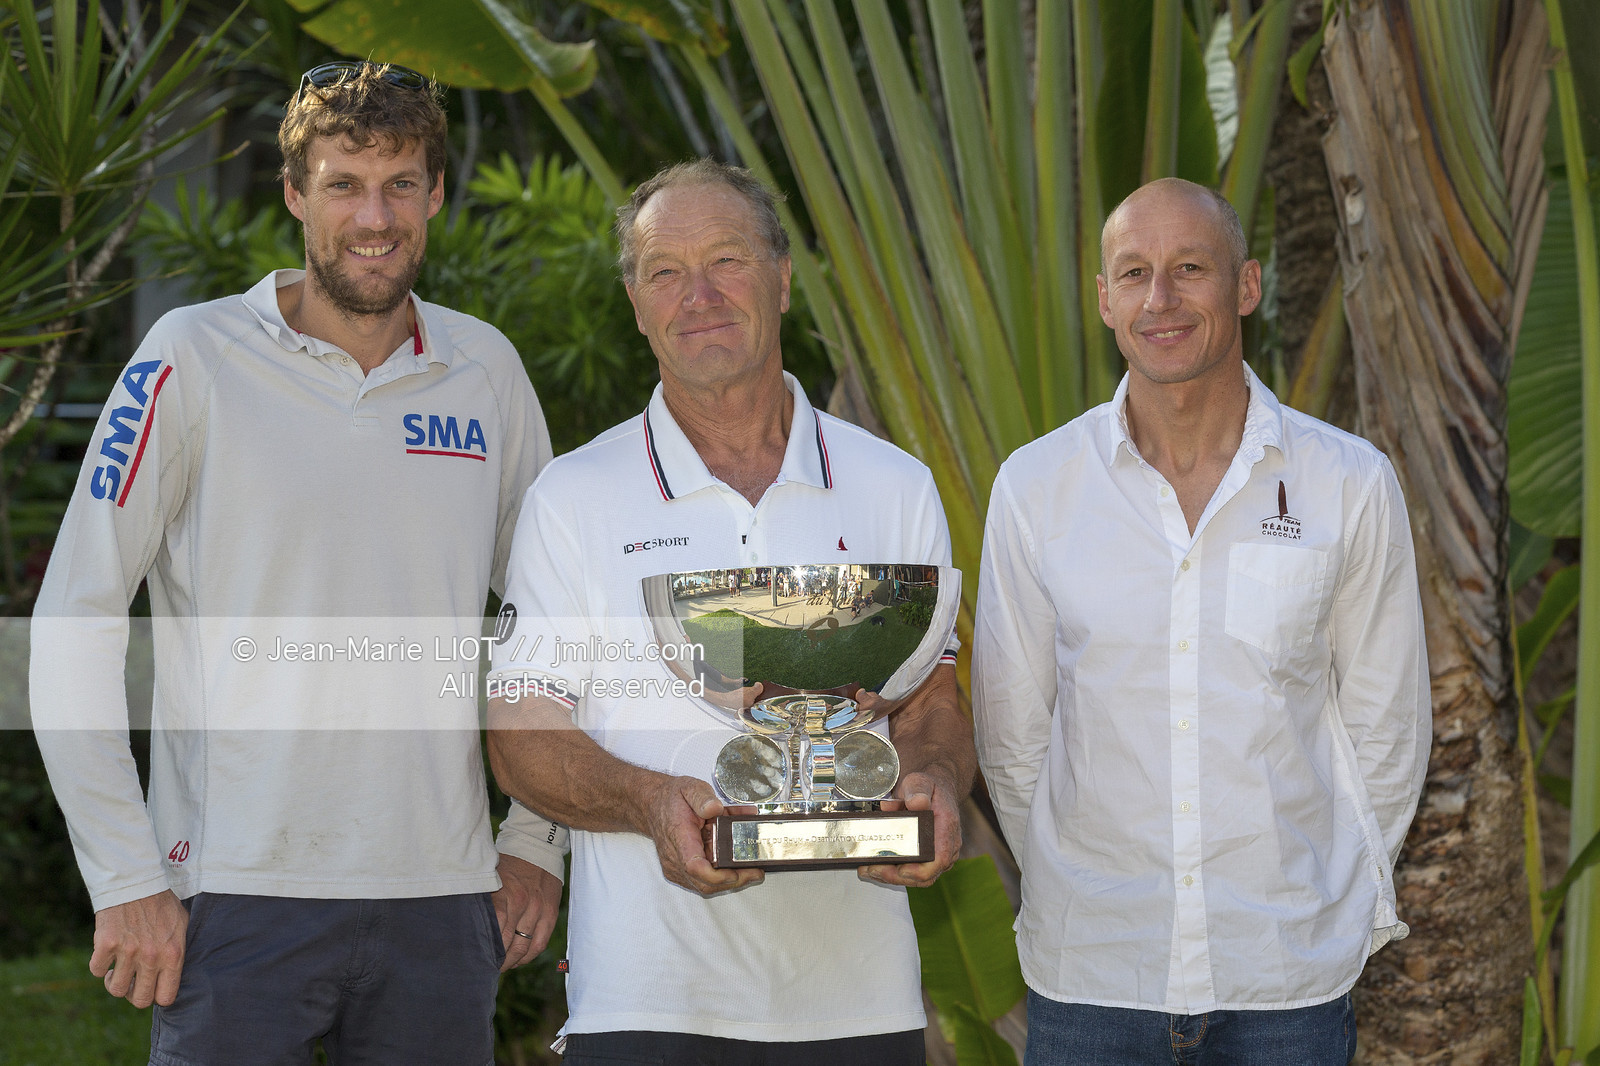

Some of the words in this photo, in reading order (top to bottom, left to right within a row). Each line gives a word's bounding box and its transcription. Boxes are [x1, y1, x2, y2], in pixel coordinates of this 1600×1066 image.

[91, 360, 162, 501] SMA
[403, 414, 486, 453] SMA
[1262, 522, 1301, 534] RÉAUTÉ
[1284, 518, 1301, 527] TEAM
[623, 541, 651, 554] IDEC
[652, 536, 690, 549] SPORT
[1261, 530, 1301, 540] CHOCOLAT
[497, 609, 515, 639] 17
[168, 840, 190, 863] 40
